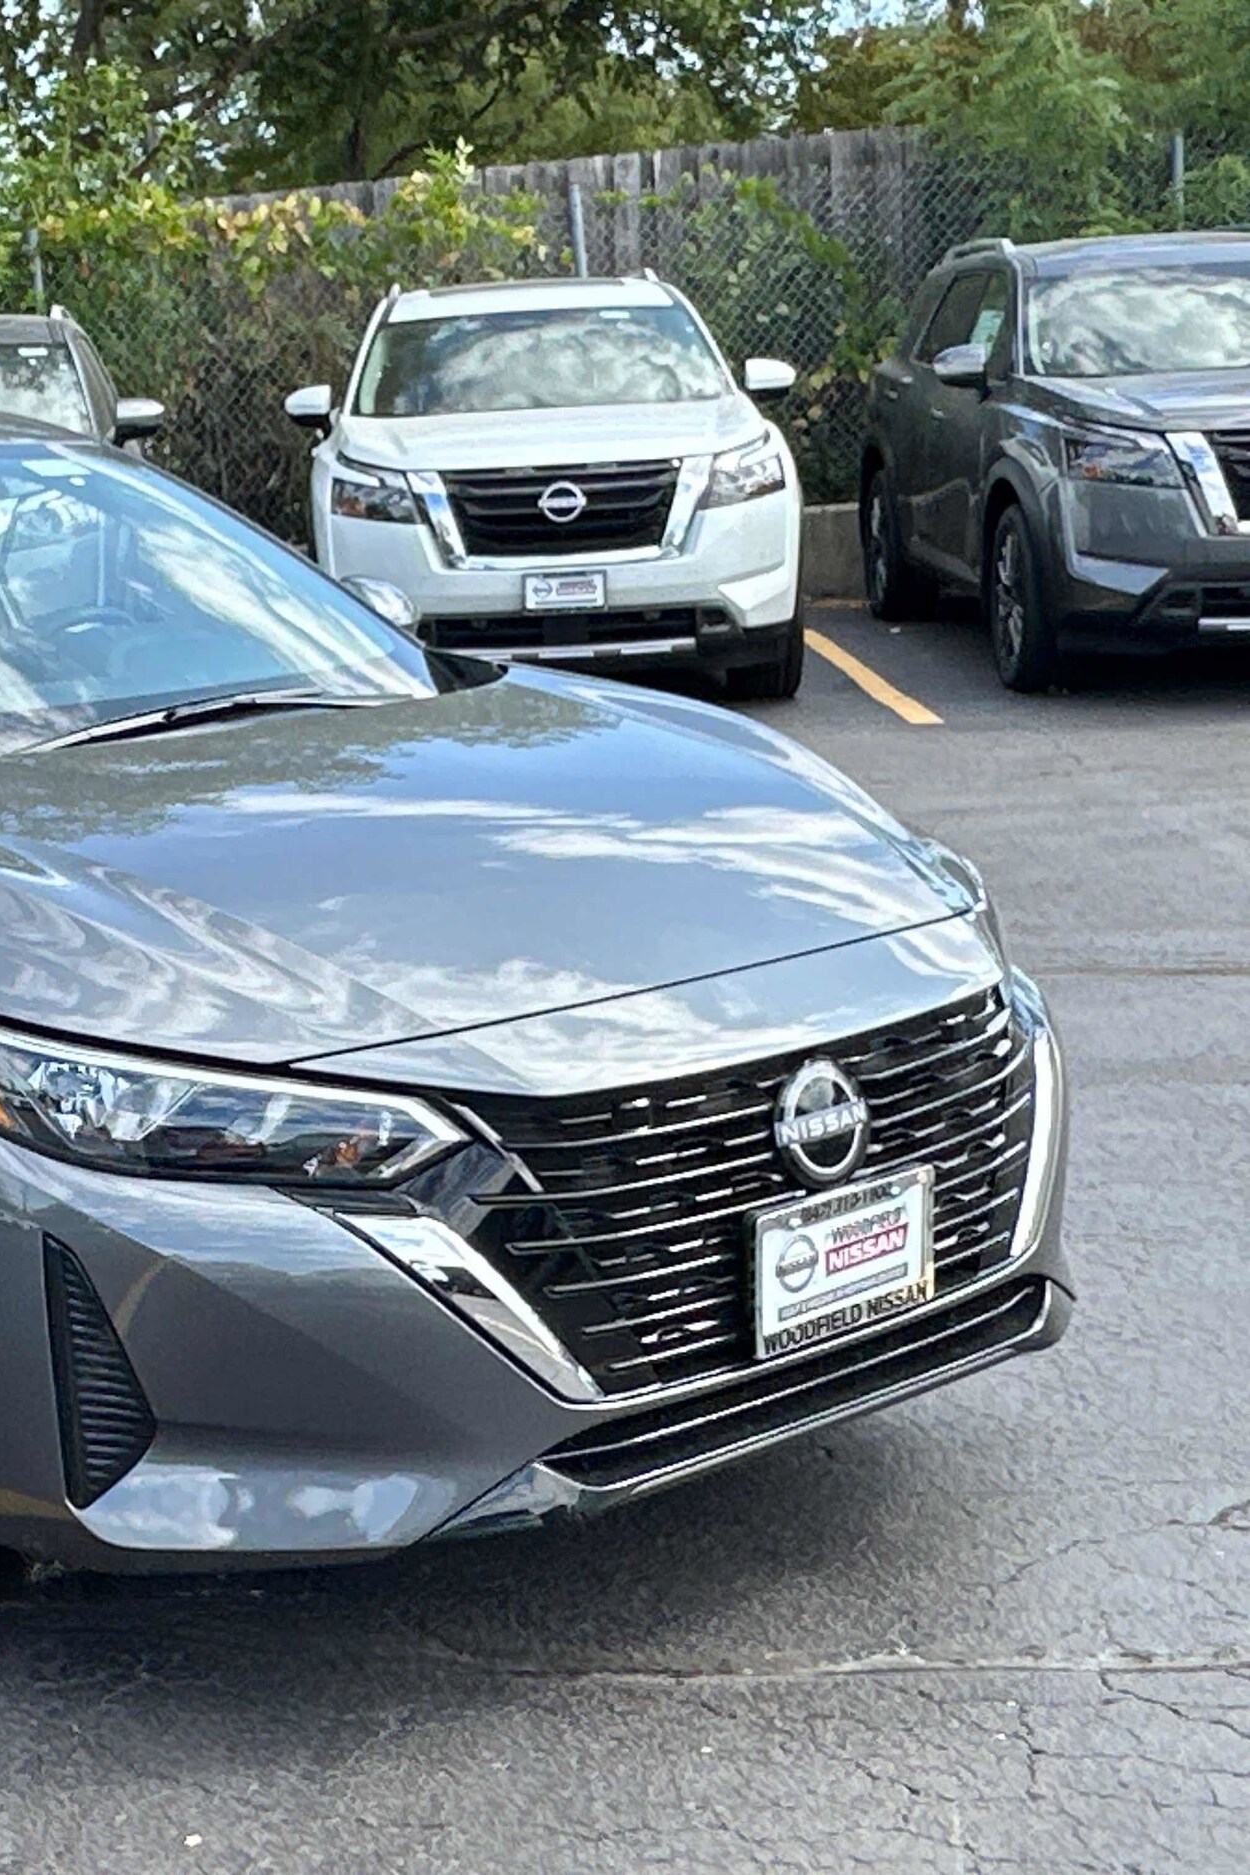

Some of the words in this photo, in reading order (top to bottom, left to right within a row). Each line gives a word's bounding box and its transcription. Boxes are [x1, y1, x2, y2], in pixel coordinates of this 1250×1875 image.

[780, 1098, 867, 1143] NISSAN
[829, 1227, 904, 1272] NISSAN
[763, 1304, 862, 1356] WOODFIELD
[867, 1280, 929, 1319] NISSAN
